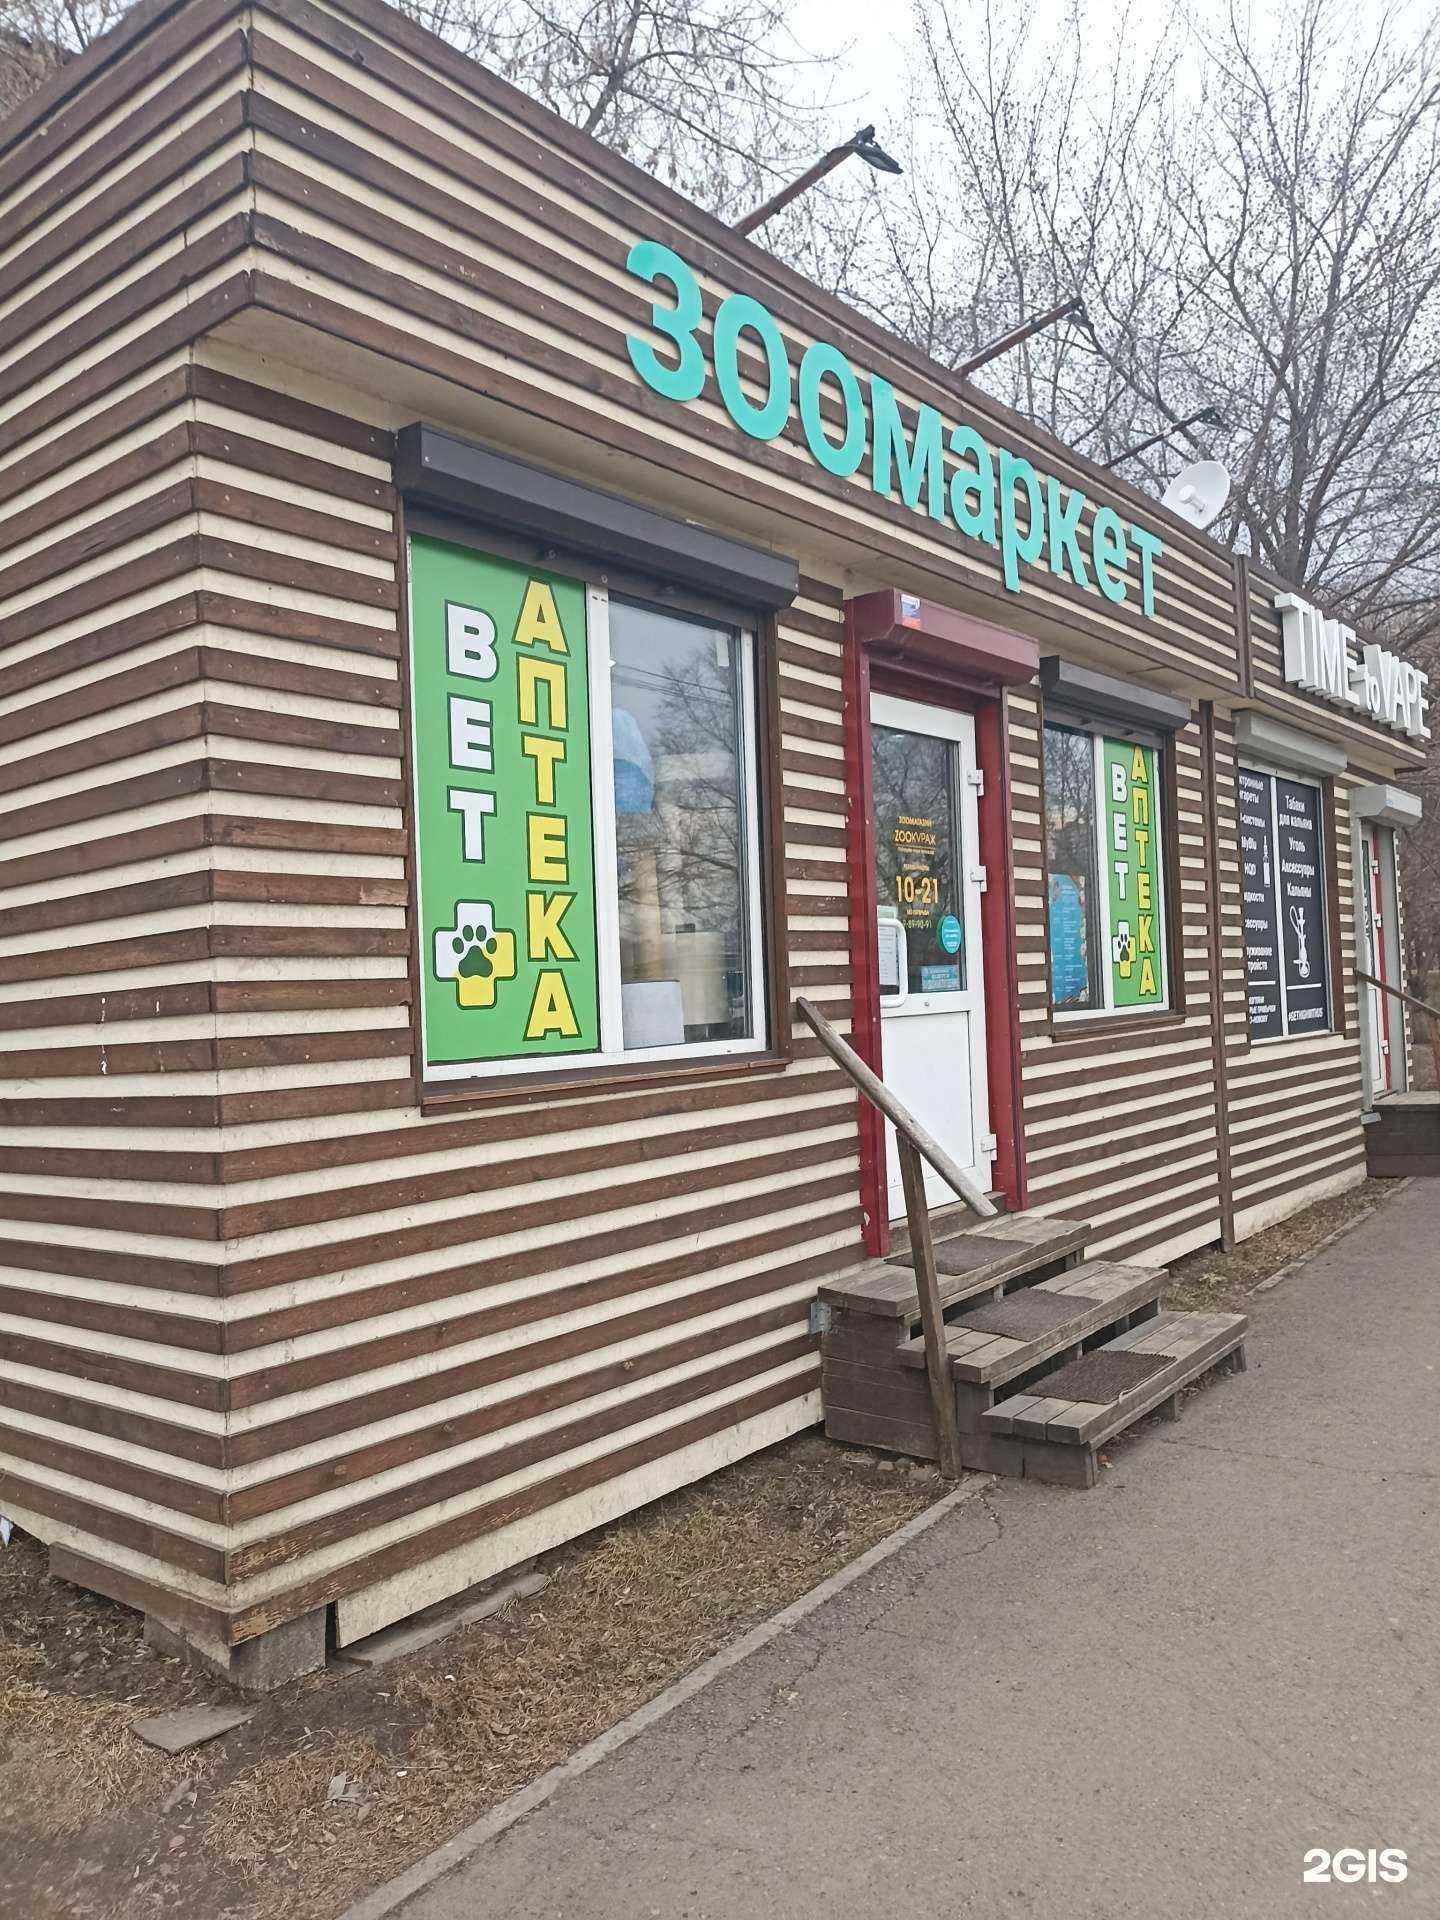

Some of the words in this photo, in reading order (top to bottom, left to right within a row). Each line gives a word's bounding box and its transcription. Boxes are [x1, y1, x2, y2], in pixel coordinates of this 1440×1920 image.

[445, 599, 500, 864] ВЕТ
[511, 576, 581, 1041] АПТЕКА
[895, 875, 939, 904] 10-21
[1111, 762, 1129, 900] ВЕТ
[1130, 745, 1157, 996] АПТЕКА
[1281, 859, 1315, 878] Аксессуары
